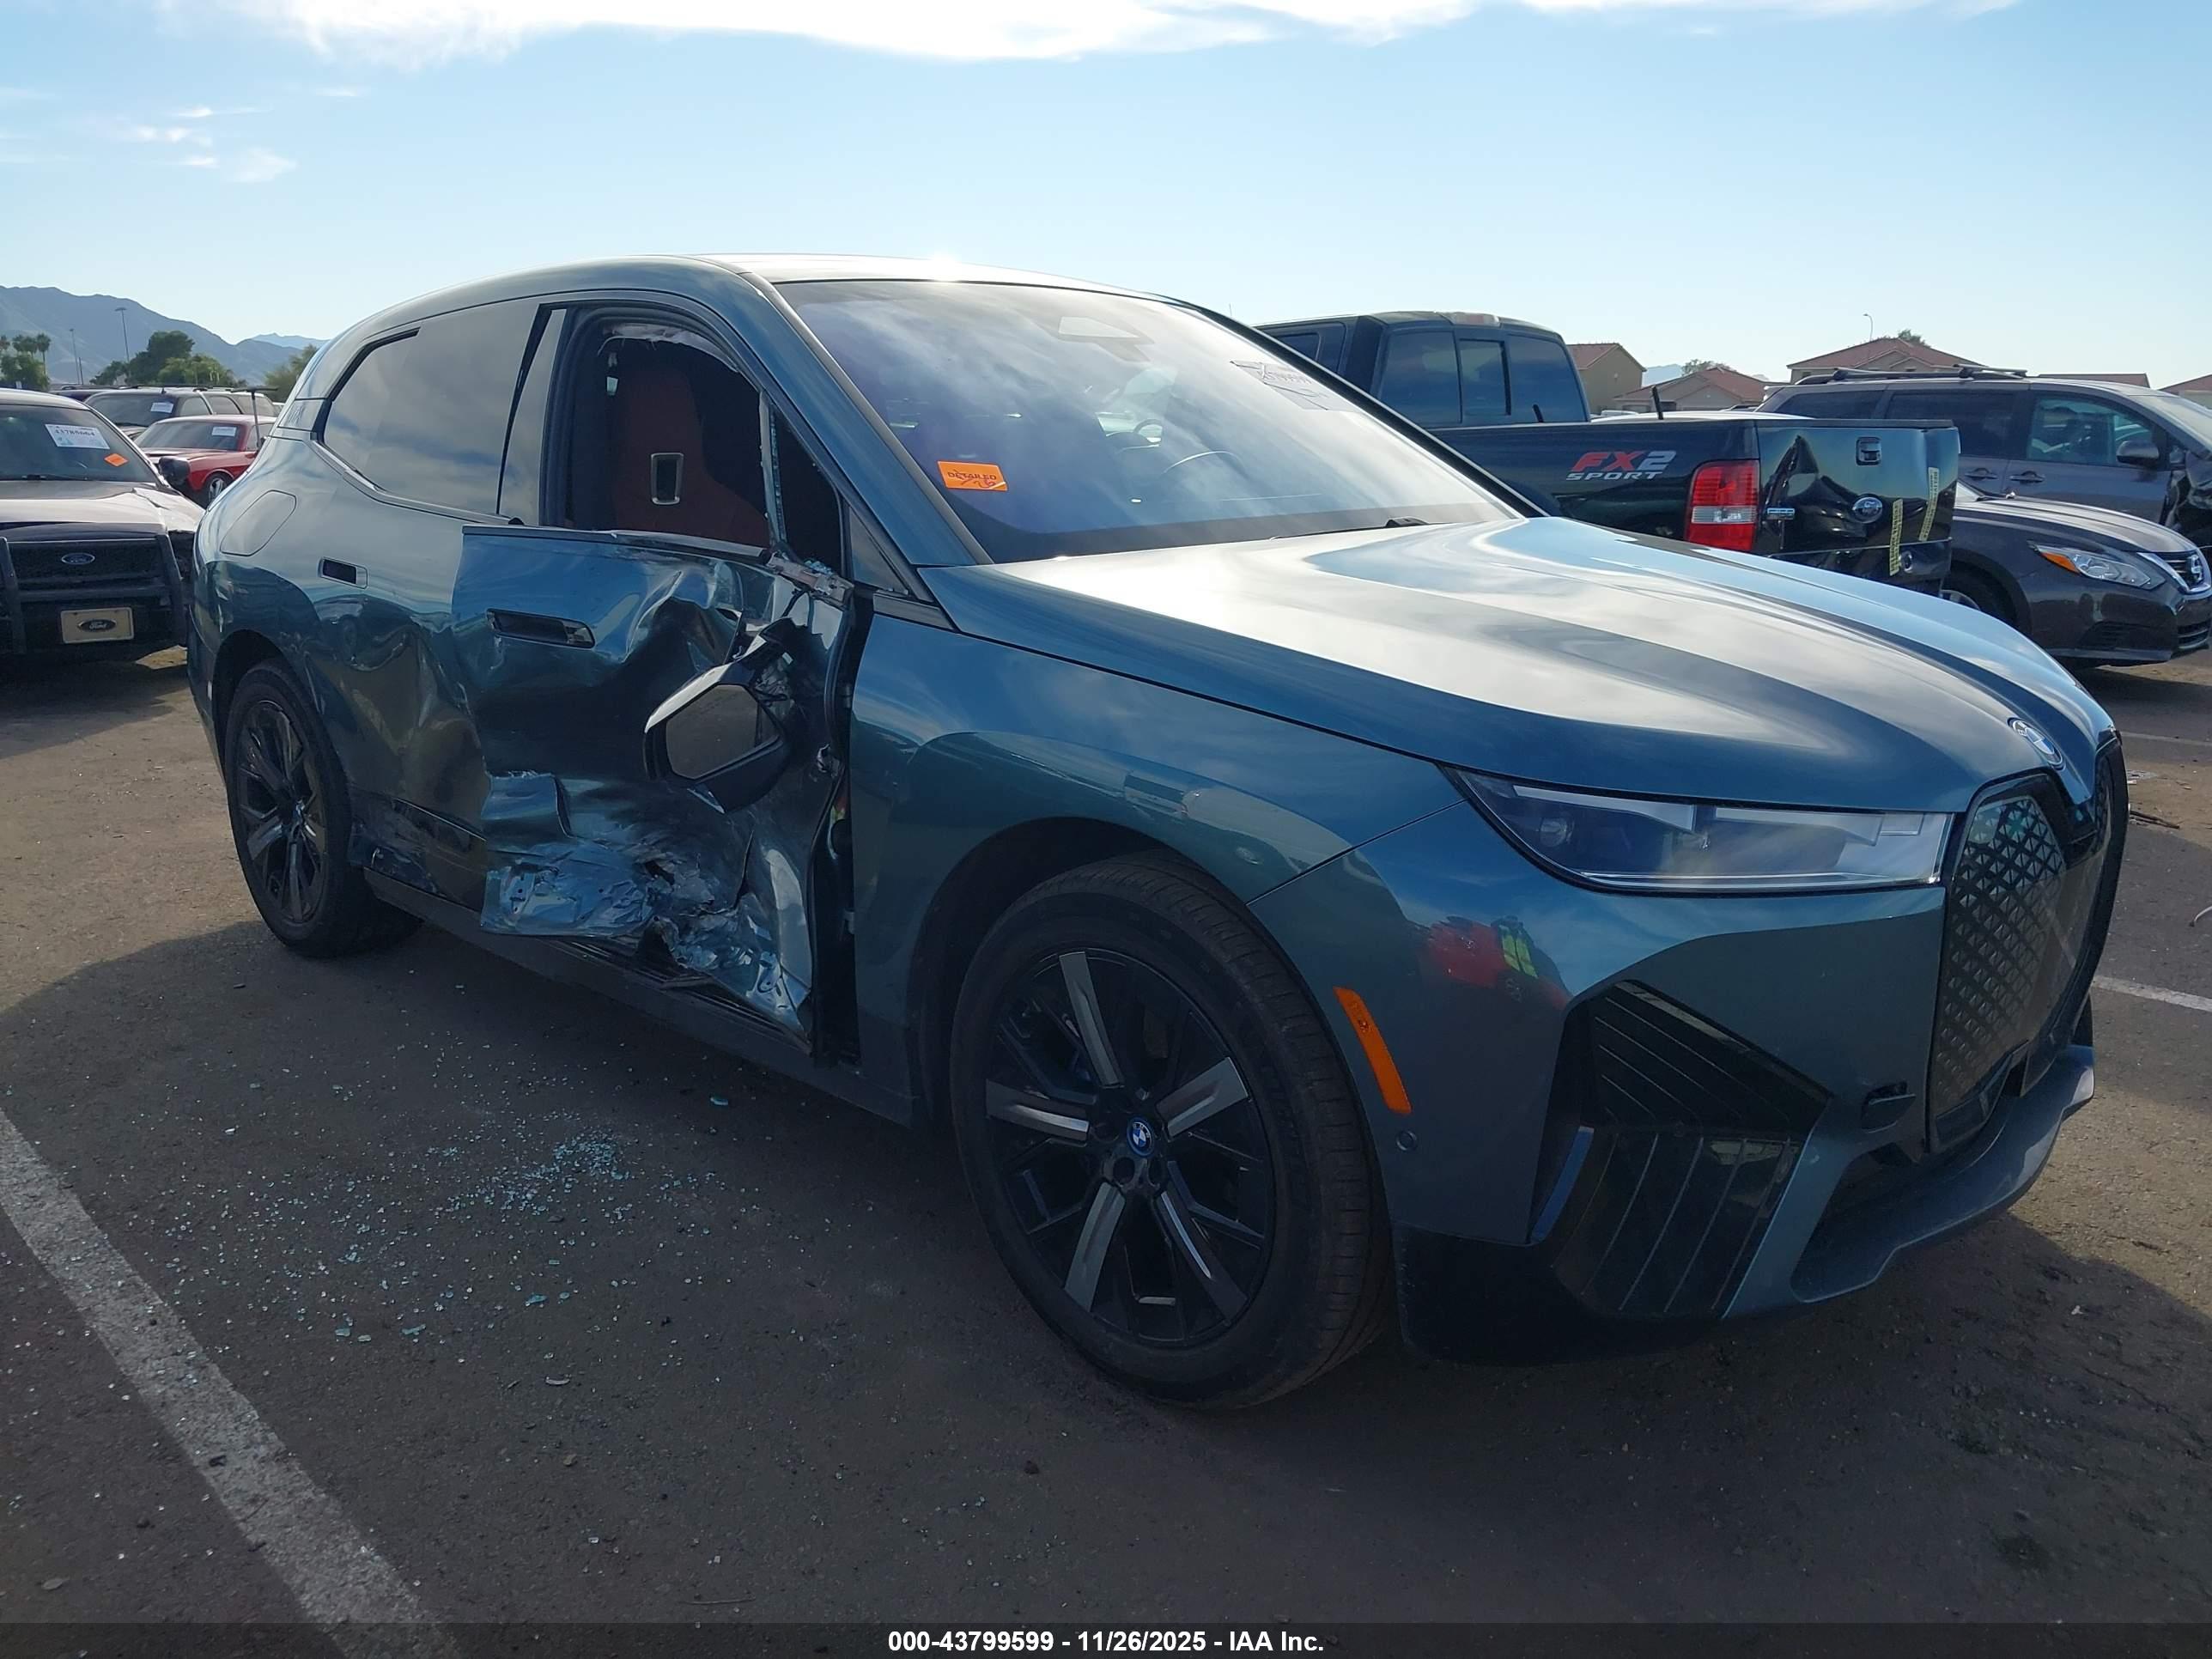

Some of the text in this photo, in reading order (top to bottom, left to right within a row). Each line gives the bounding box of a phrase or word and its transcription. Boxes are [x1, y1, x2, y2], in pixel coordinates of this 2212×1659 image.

[1571, 450, 1677, 472] FX2
[947, 471, 996, 480] DETAILED
[1565, 471, 1663, 481] SPORT
